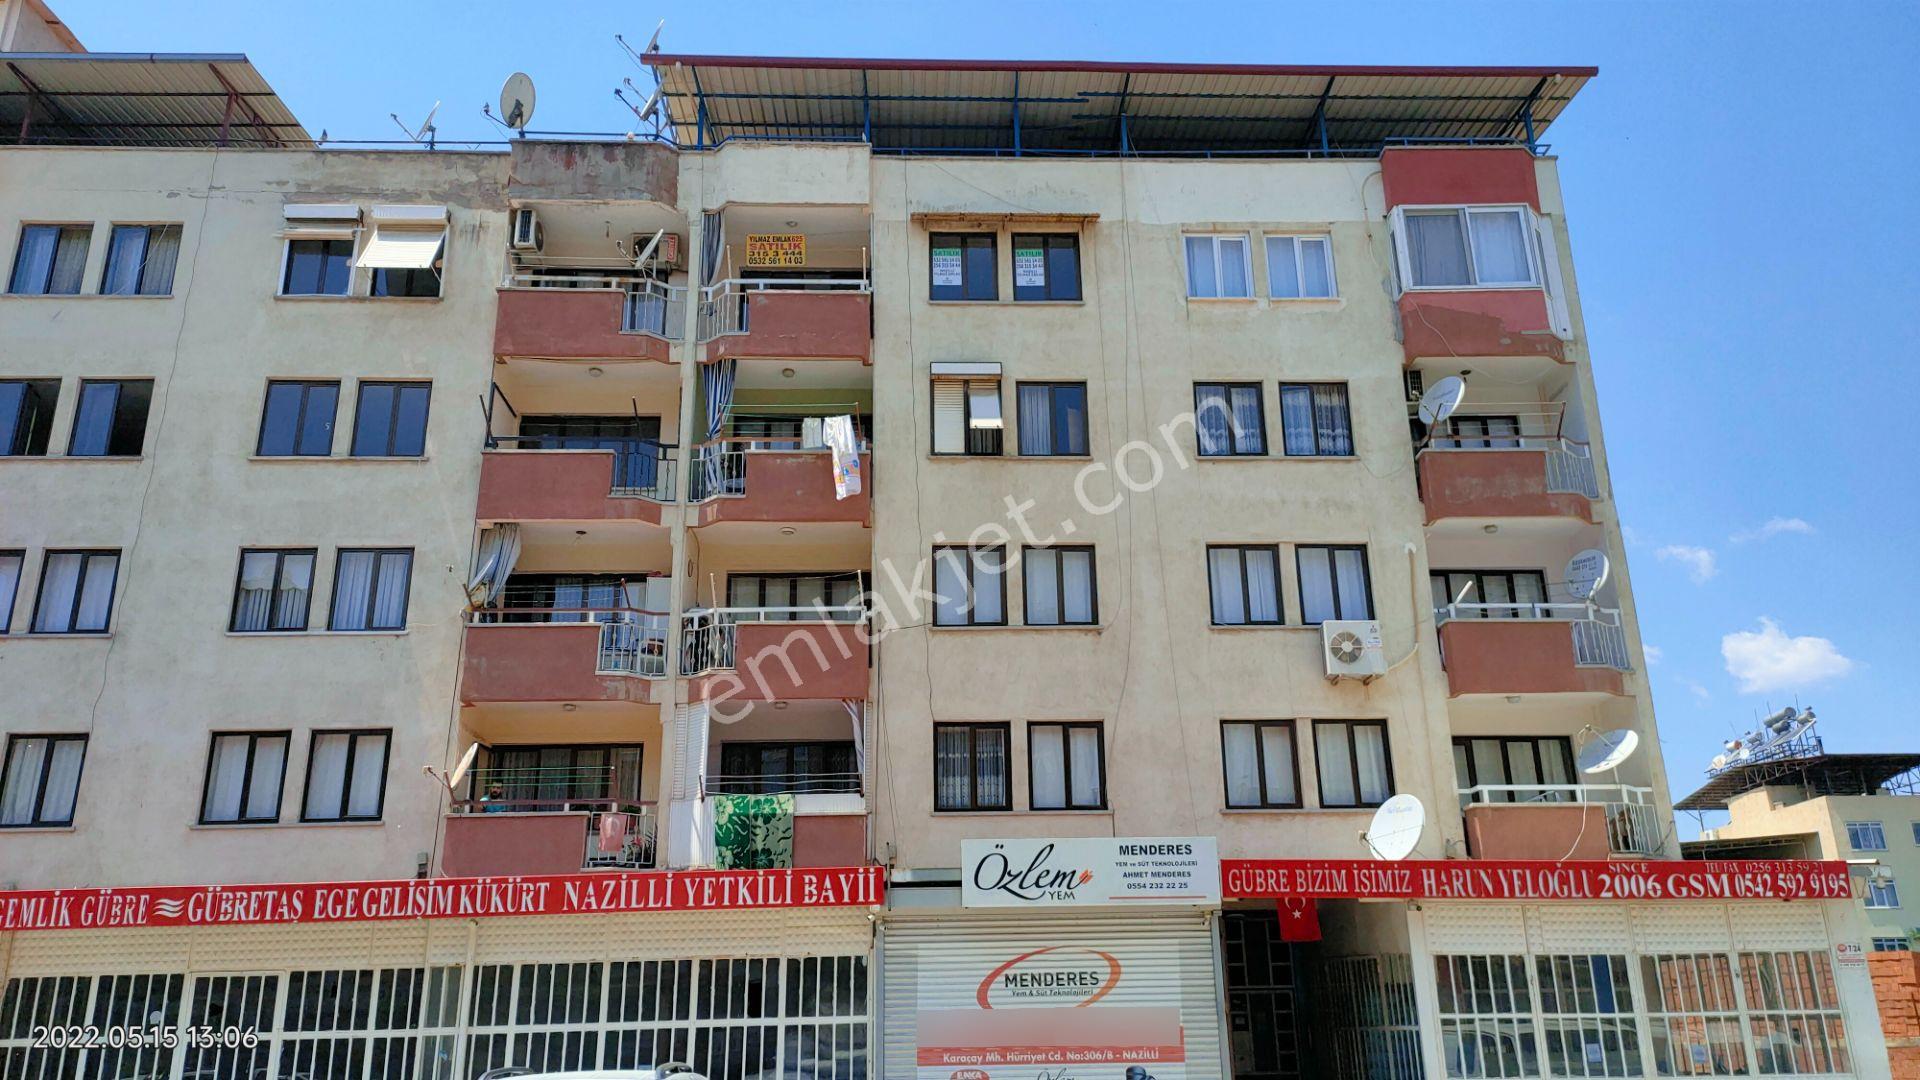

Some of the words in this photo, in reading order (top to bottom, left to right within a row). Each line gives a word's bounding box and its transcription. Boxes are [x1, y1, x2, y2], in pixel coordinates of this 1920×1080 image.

[1119, 845, 1193, 855] MENDERES
[974, 843, 1088, 900] Özlem
[1609, 863, 1649, 873] SINCE
[1705, 863, 1720, 873] TEL
[1724, 863, 1740, 873] FAX
[1746, 863, 1771, 873] 0256
[1775, 863, 1793, 873] 313
[1229, 864, 1290, 893] GÜBRE
[1295, 863, 1348, 893] BİZİM
[1354, 864, 1412, 895] İŞİMİZ
[1422, 869, 1494, 897] HARUN
[1498, 863, 1593, 897] YELOĞLU
[1598, 874, 1662, 897] 2006
[1667, 873, 1731, 897] GSM
[1735, 874, 1773, 897] 0542
[1777, 874, 1806, 897] 592
[1810, 873, 1849, 897] 9195
[81, 889, 150, 926] GÜBRE
[188, 886, 304, 923] GÜBRETAŞ
[313, 888, 360, 918] EGE
[362, 880, 454, 919] GELİŞİM
[459, 877, 550, 914] KÜKÜRT
[562, 873, 673, 911] NAZİLLİ
[683, 870, 793, 907] YETKİLİ
[803, 867, 876, 905] BAYİİ
[1048, 891, 1076, 900] YEM
[1005, 972, 1099, 987] MENDERES
[943, 1053, 982, 1064] Karaçay
[986, 1052, 1004, 1062] Mh.
[1007, 1051, 1046, 1063] Hürriyet
[1048, 1051, 1063, 1061] Cd.
[1123, 1048, 1159, 1060] NAZİLLİ
